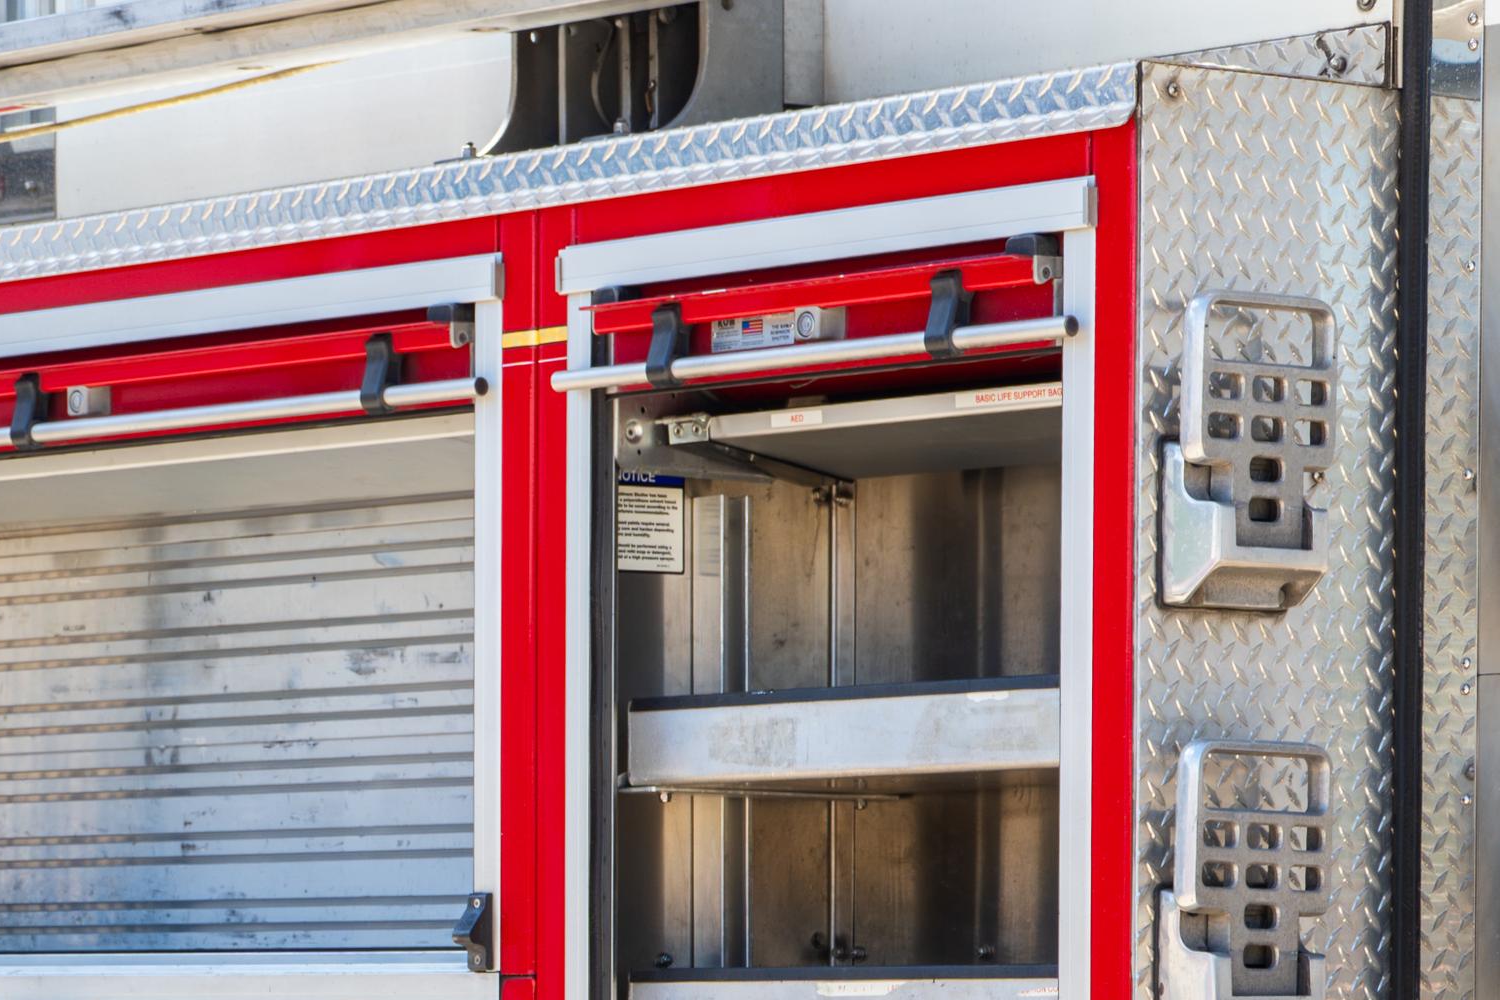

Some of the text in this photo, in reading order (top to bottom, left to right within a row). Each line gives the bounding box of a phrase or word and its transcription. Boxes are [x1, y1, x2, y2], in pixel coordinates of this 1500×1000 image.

[975, 394, 996, 404] BASIC
[998, 391, 1011, 401] LIFE
[1013, 389, 1046, 400] SUPPORT
